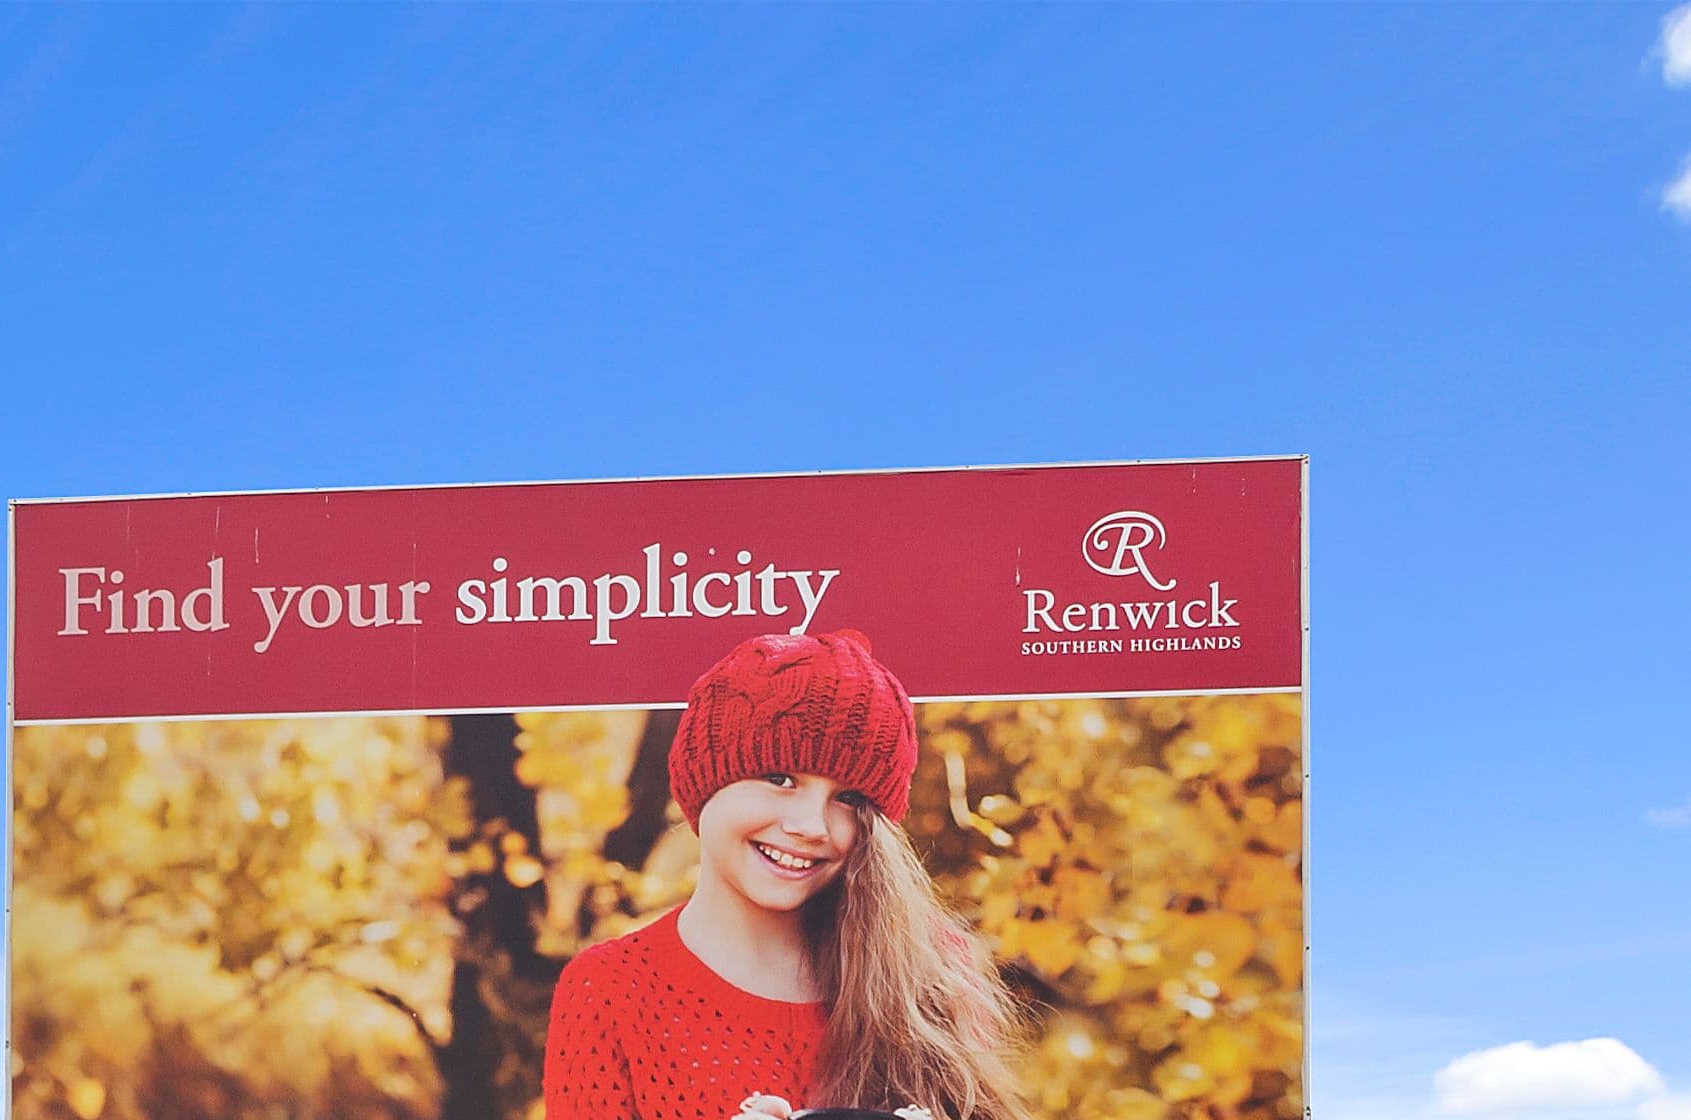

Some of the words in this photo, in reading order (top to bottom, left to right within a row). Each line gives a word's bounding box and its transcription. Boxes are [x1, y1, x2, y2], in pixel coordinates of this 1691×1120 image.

[57, 557, 230, 637] Find
[251, 580, 431, 654] your
[455, 543, 841, 645] simplicity
[1021, 580, 1241, 633] Renwick
[1021, 639, 1123, 656] SOUTHERN
[1130, 635, 1242, 652] HIGHLANDS
